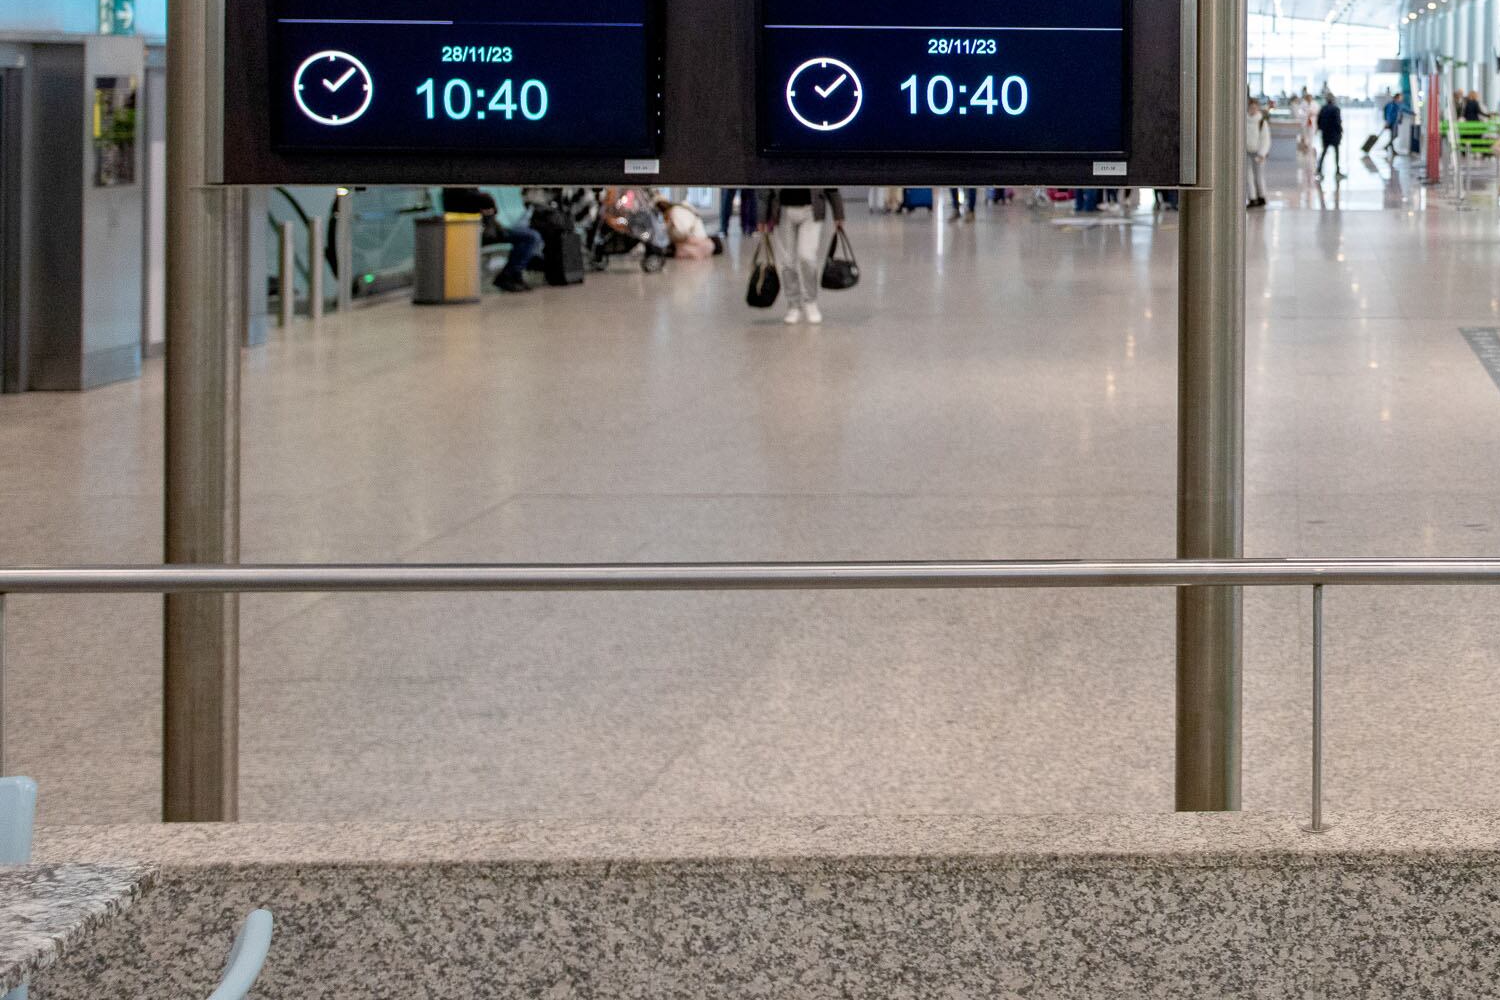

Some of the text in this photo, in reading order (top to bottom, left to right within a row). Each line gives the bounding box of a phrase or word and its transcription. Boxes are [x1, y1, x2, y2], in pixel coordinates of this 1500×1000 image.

[442, 46, 513, 63] 28/11/23
[928, 39, 997, 55] 28/11/23
[416, 78, 548, 120] 10:40
[900, 75, 1029, 115] 10:40
